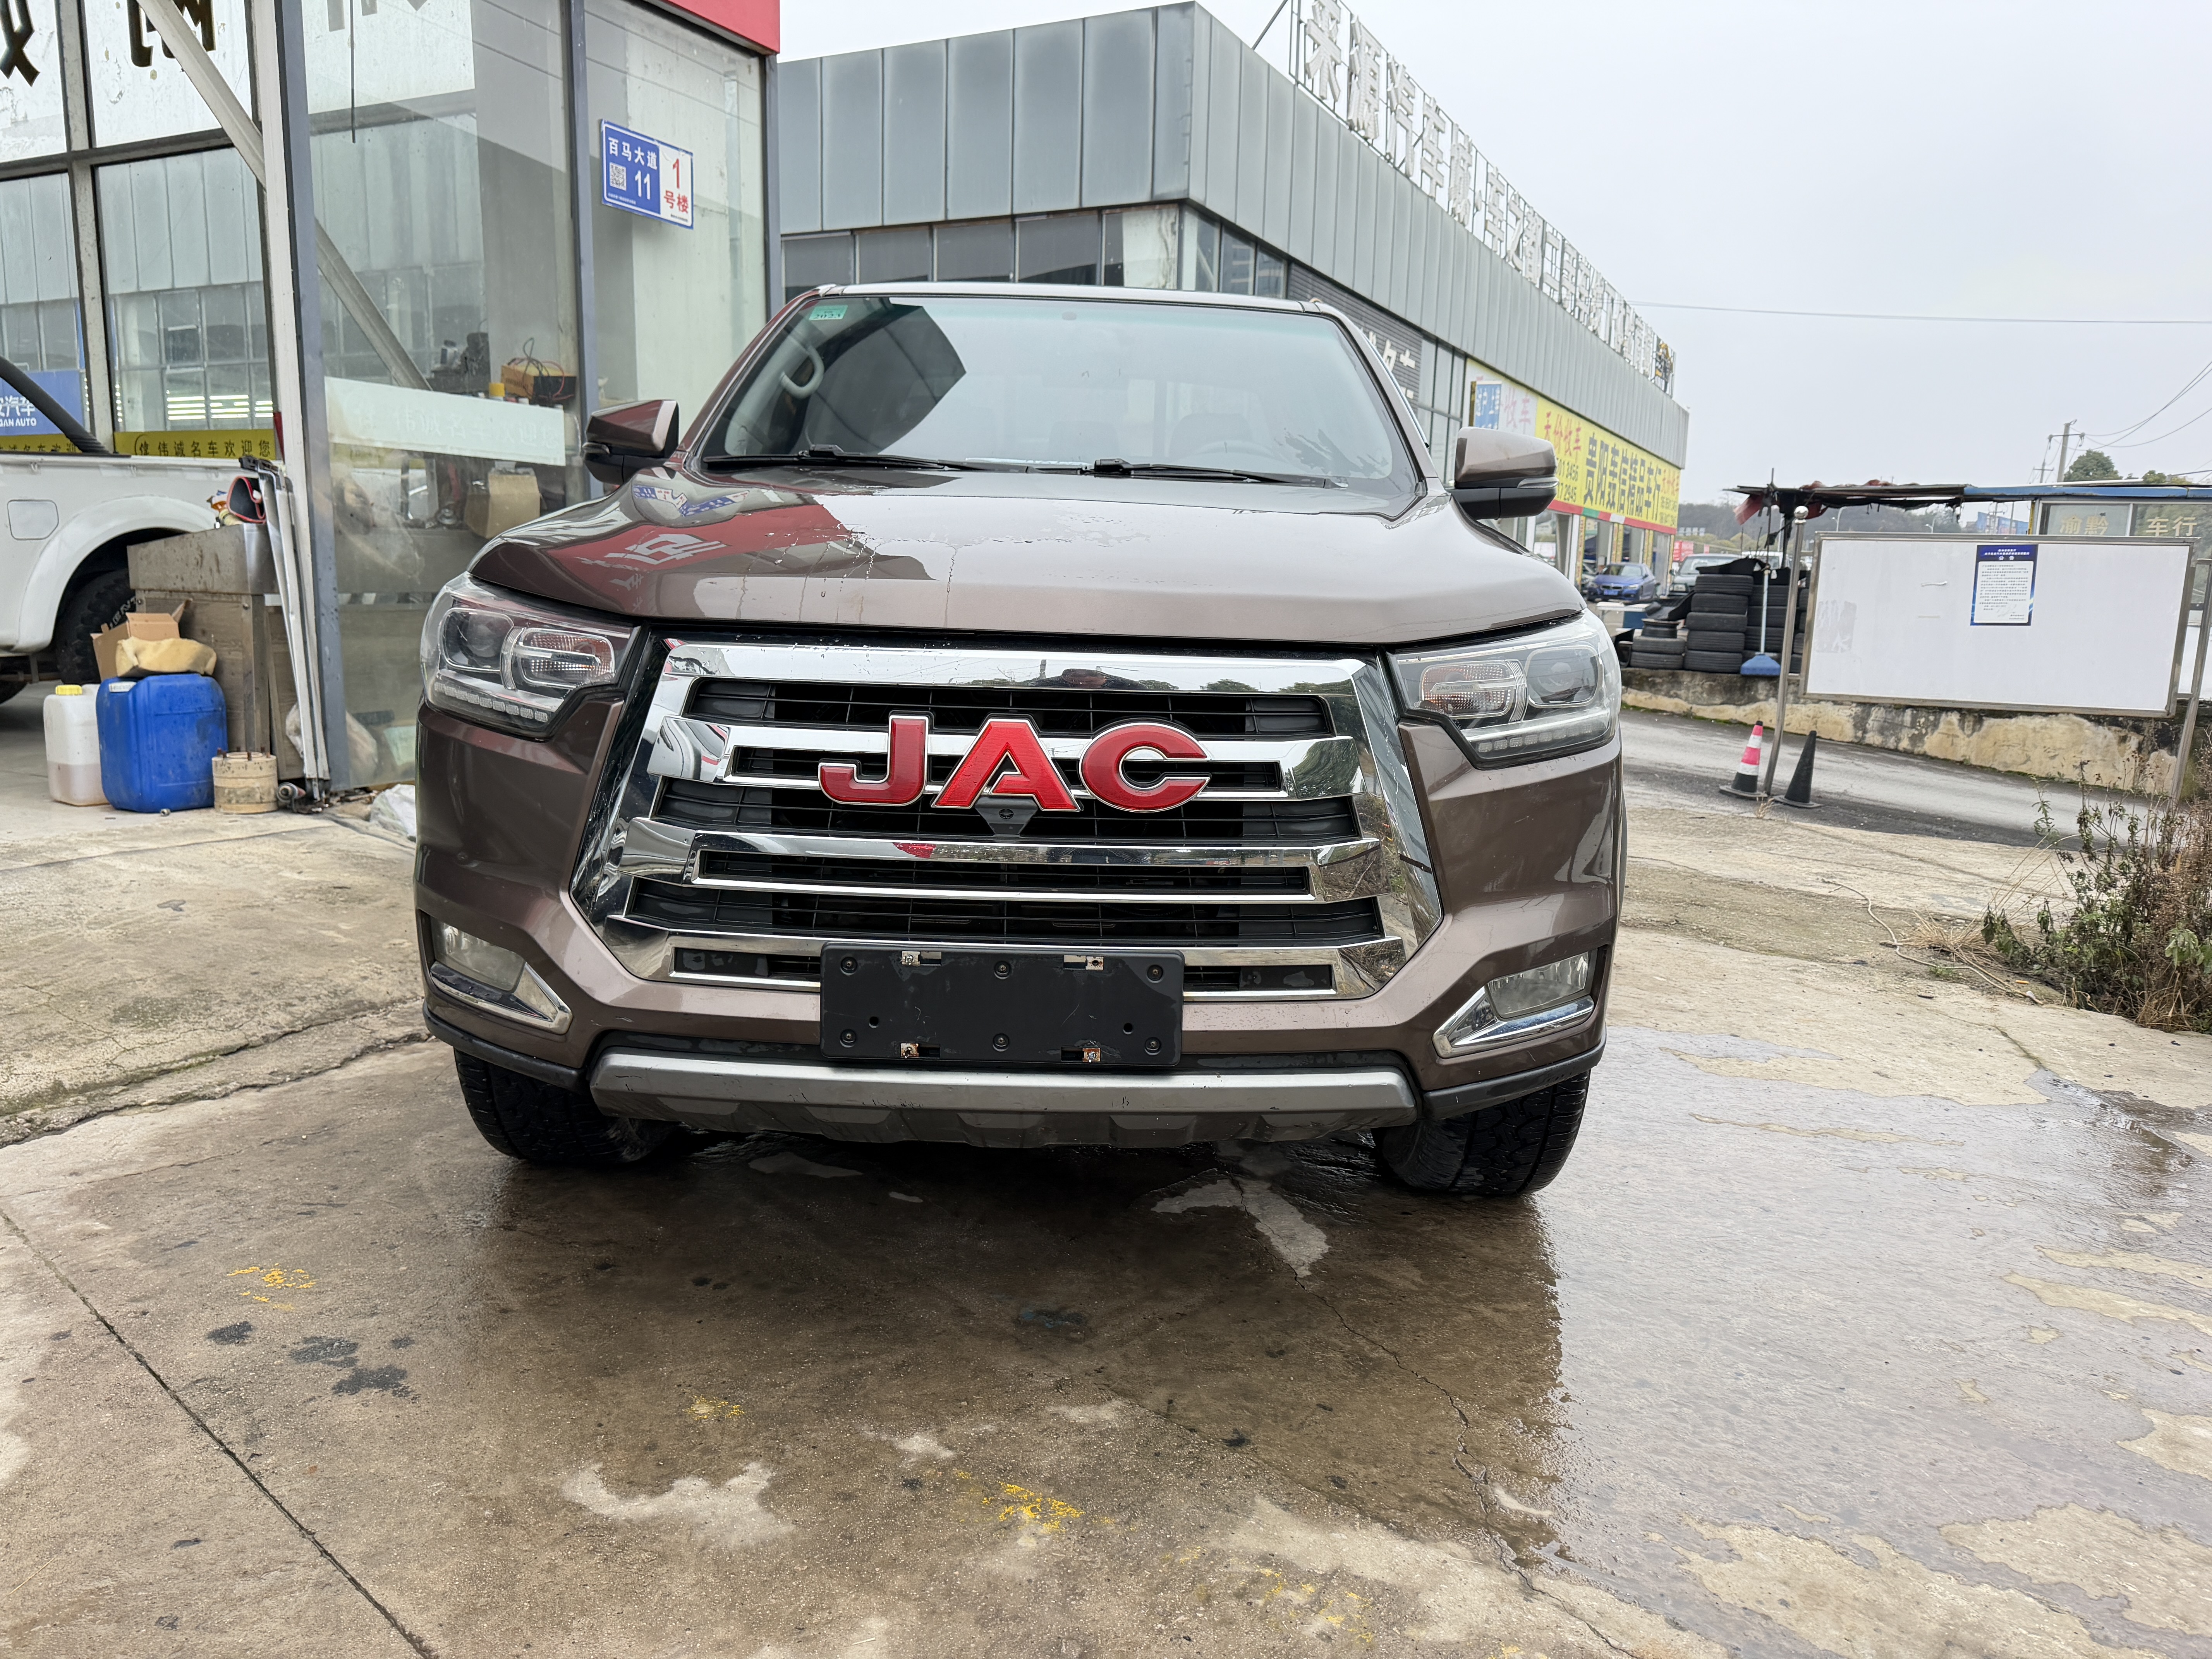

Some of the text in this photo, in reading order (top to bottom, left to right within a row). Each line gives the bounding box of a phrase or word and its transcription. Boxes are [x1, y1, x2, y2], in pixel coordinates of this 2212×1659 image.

[608, 137, 657, 170] 百马大道
[635, 170, 651, 200] 11
[672, 158, 680, 189] 1
[663, 190, 689, 214] 号楼
[15, 417, 37, 426] AUTO
[2059, 515, 2197, 536] 渝黔 车行
[818, 715, 1211, 812] JAC
